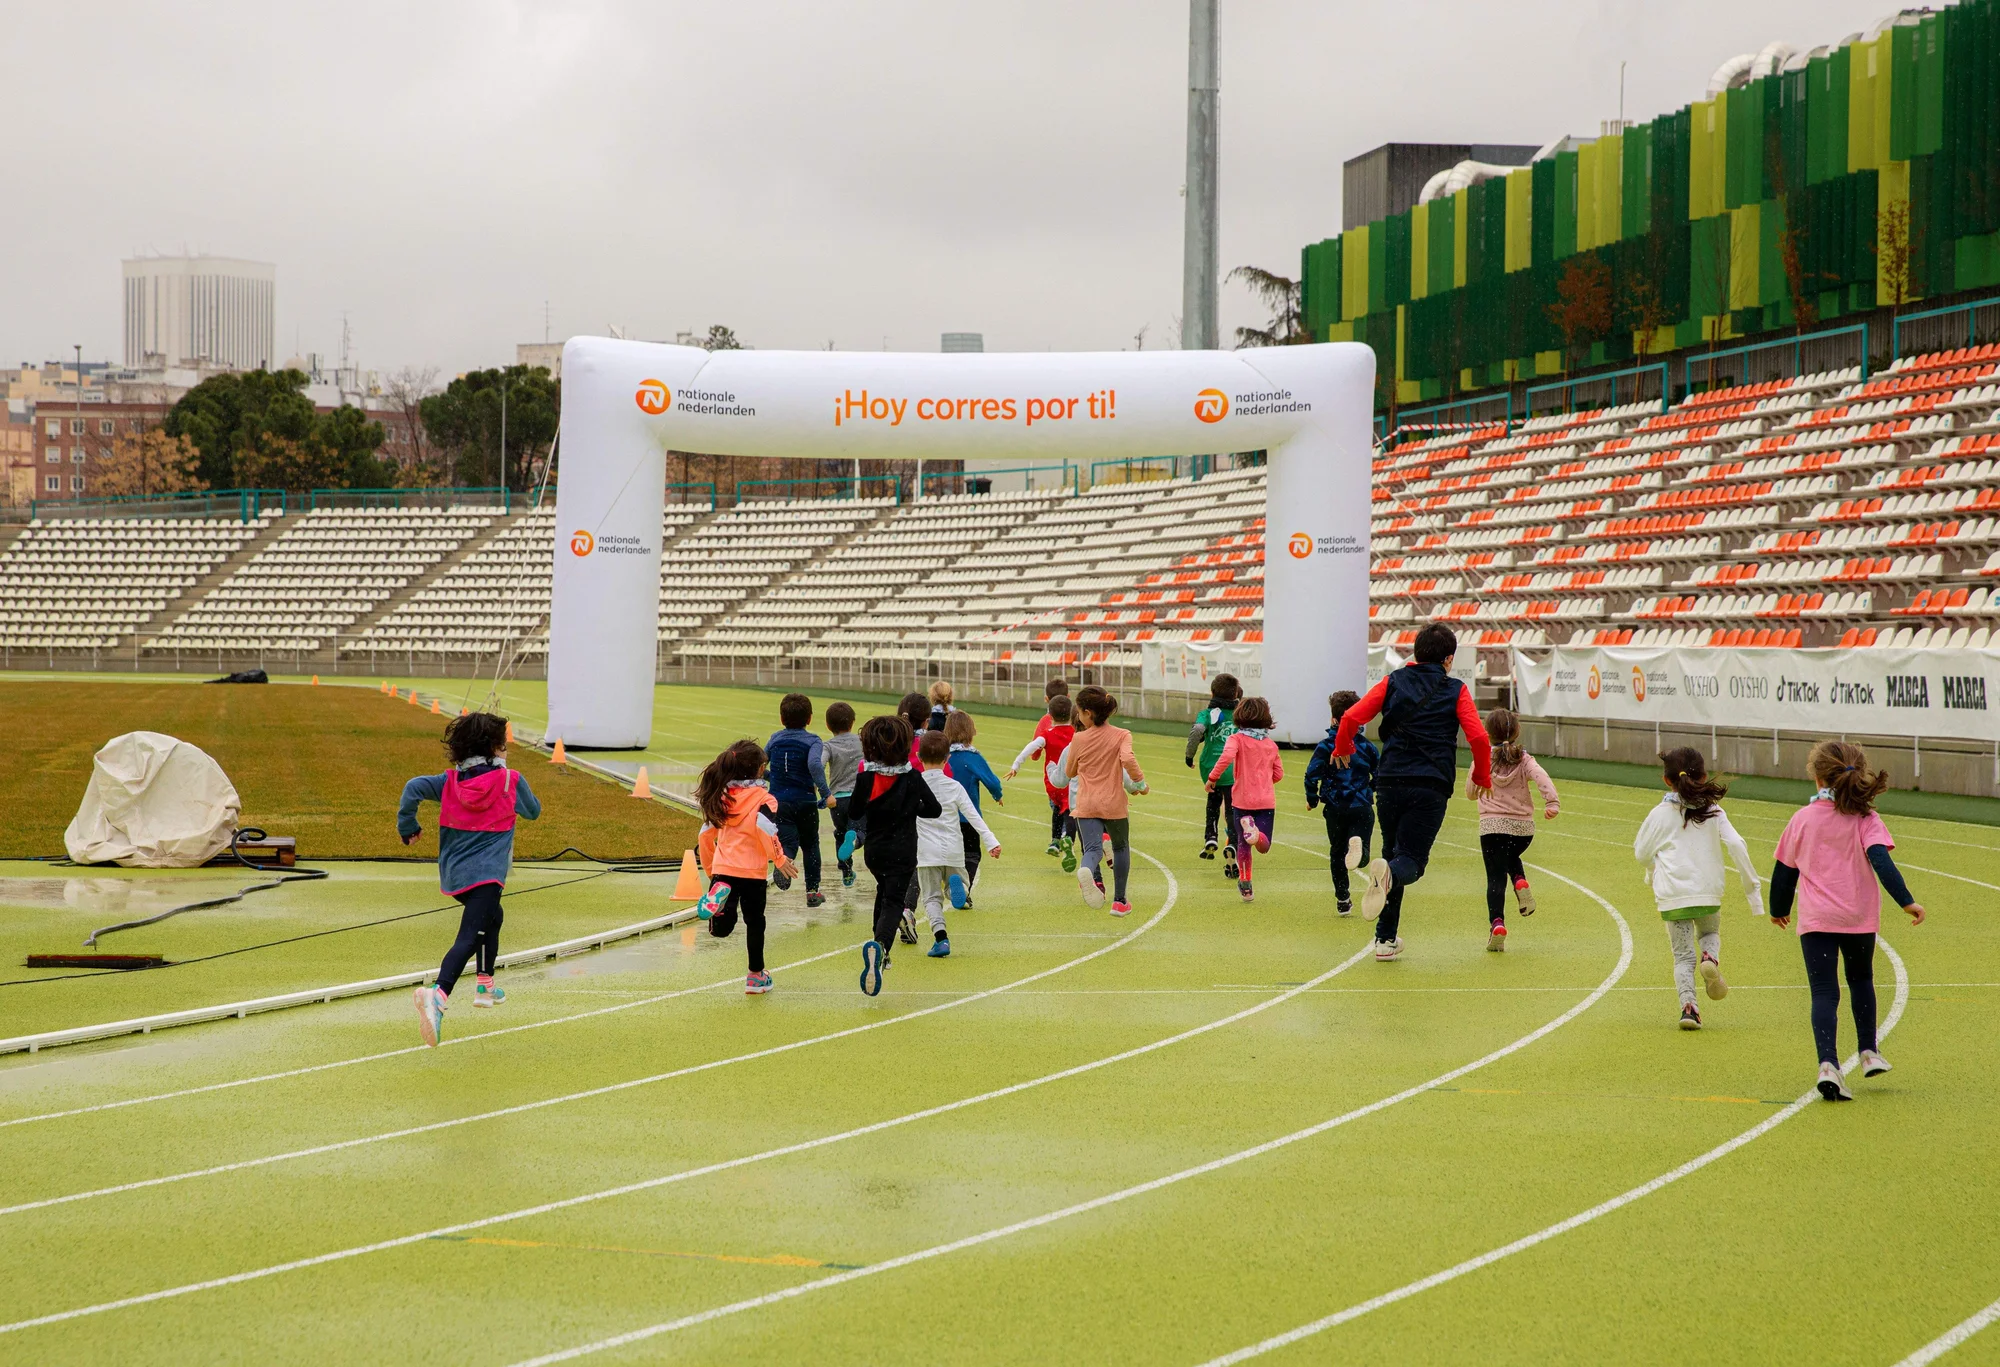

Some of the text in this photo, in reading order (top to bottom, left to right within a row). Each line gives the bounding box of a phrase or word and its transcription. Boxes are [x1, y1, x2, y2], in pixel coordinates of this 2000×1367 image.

[677, 389, 736, 403] nationale
[1235, 389, 1292, 403] nationale
[677, 402, 756, 416] nederlanden
[835, 389, 1116, 426] ¡Hoy corres por ti!
[1235, 401, 1312, 416] nederlanden
[598, 535, 641, 545] nationale
[1317, 535, 1357, 545] nationale
[598, 545, 651, 555] nederlanden
[1317, 545, 1365, 554] nederlanden
[1684, 675, 1719, 698] OYSHO
[1729, 675, 1769, 700] OYSHO
[1788, 682, 1820, 703] TikTok
[1839, 683, 1875, 705] TikTok
[1886, 675, 1930, 708] MARCA
[1942, 675, 1987, 710] MARCA
